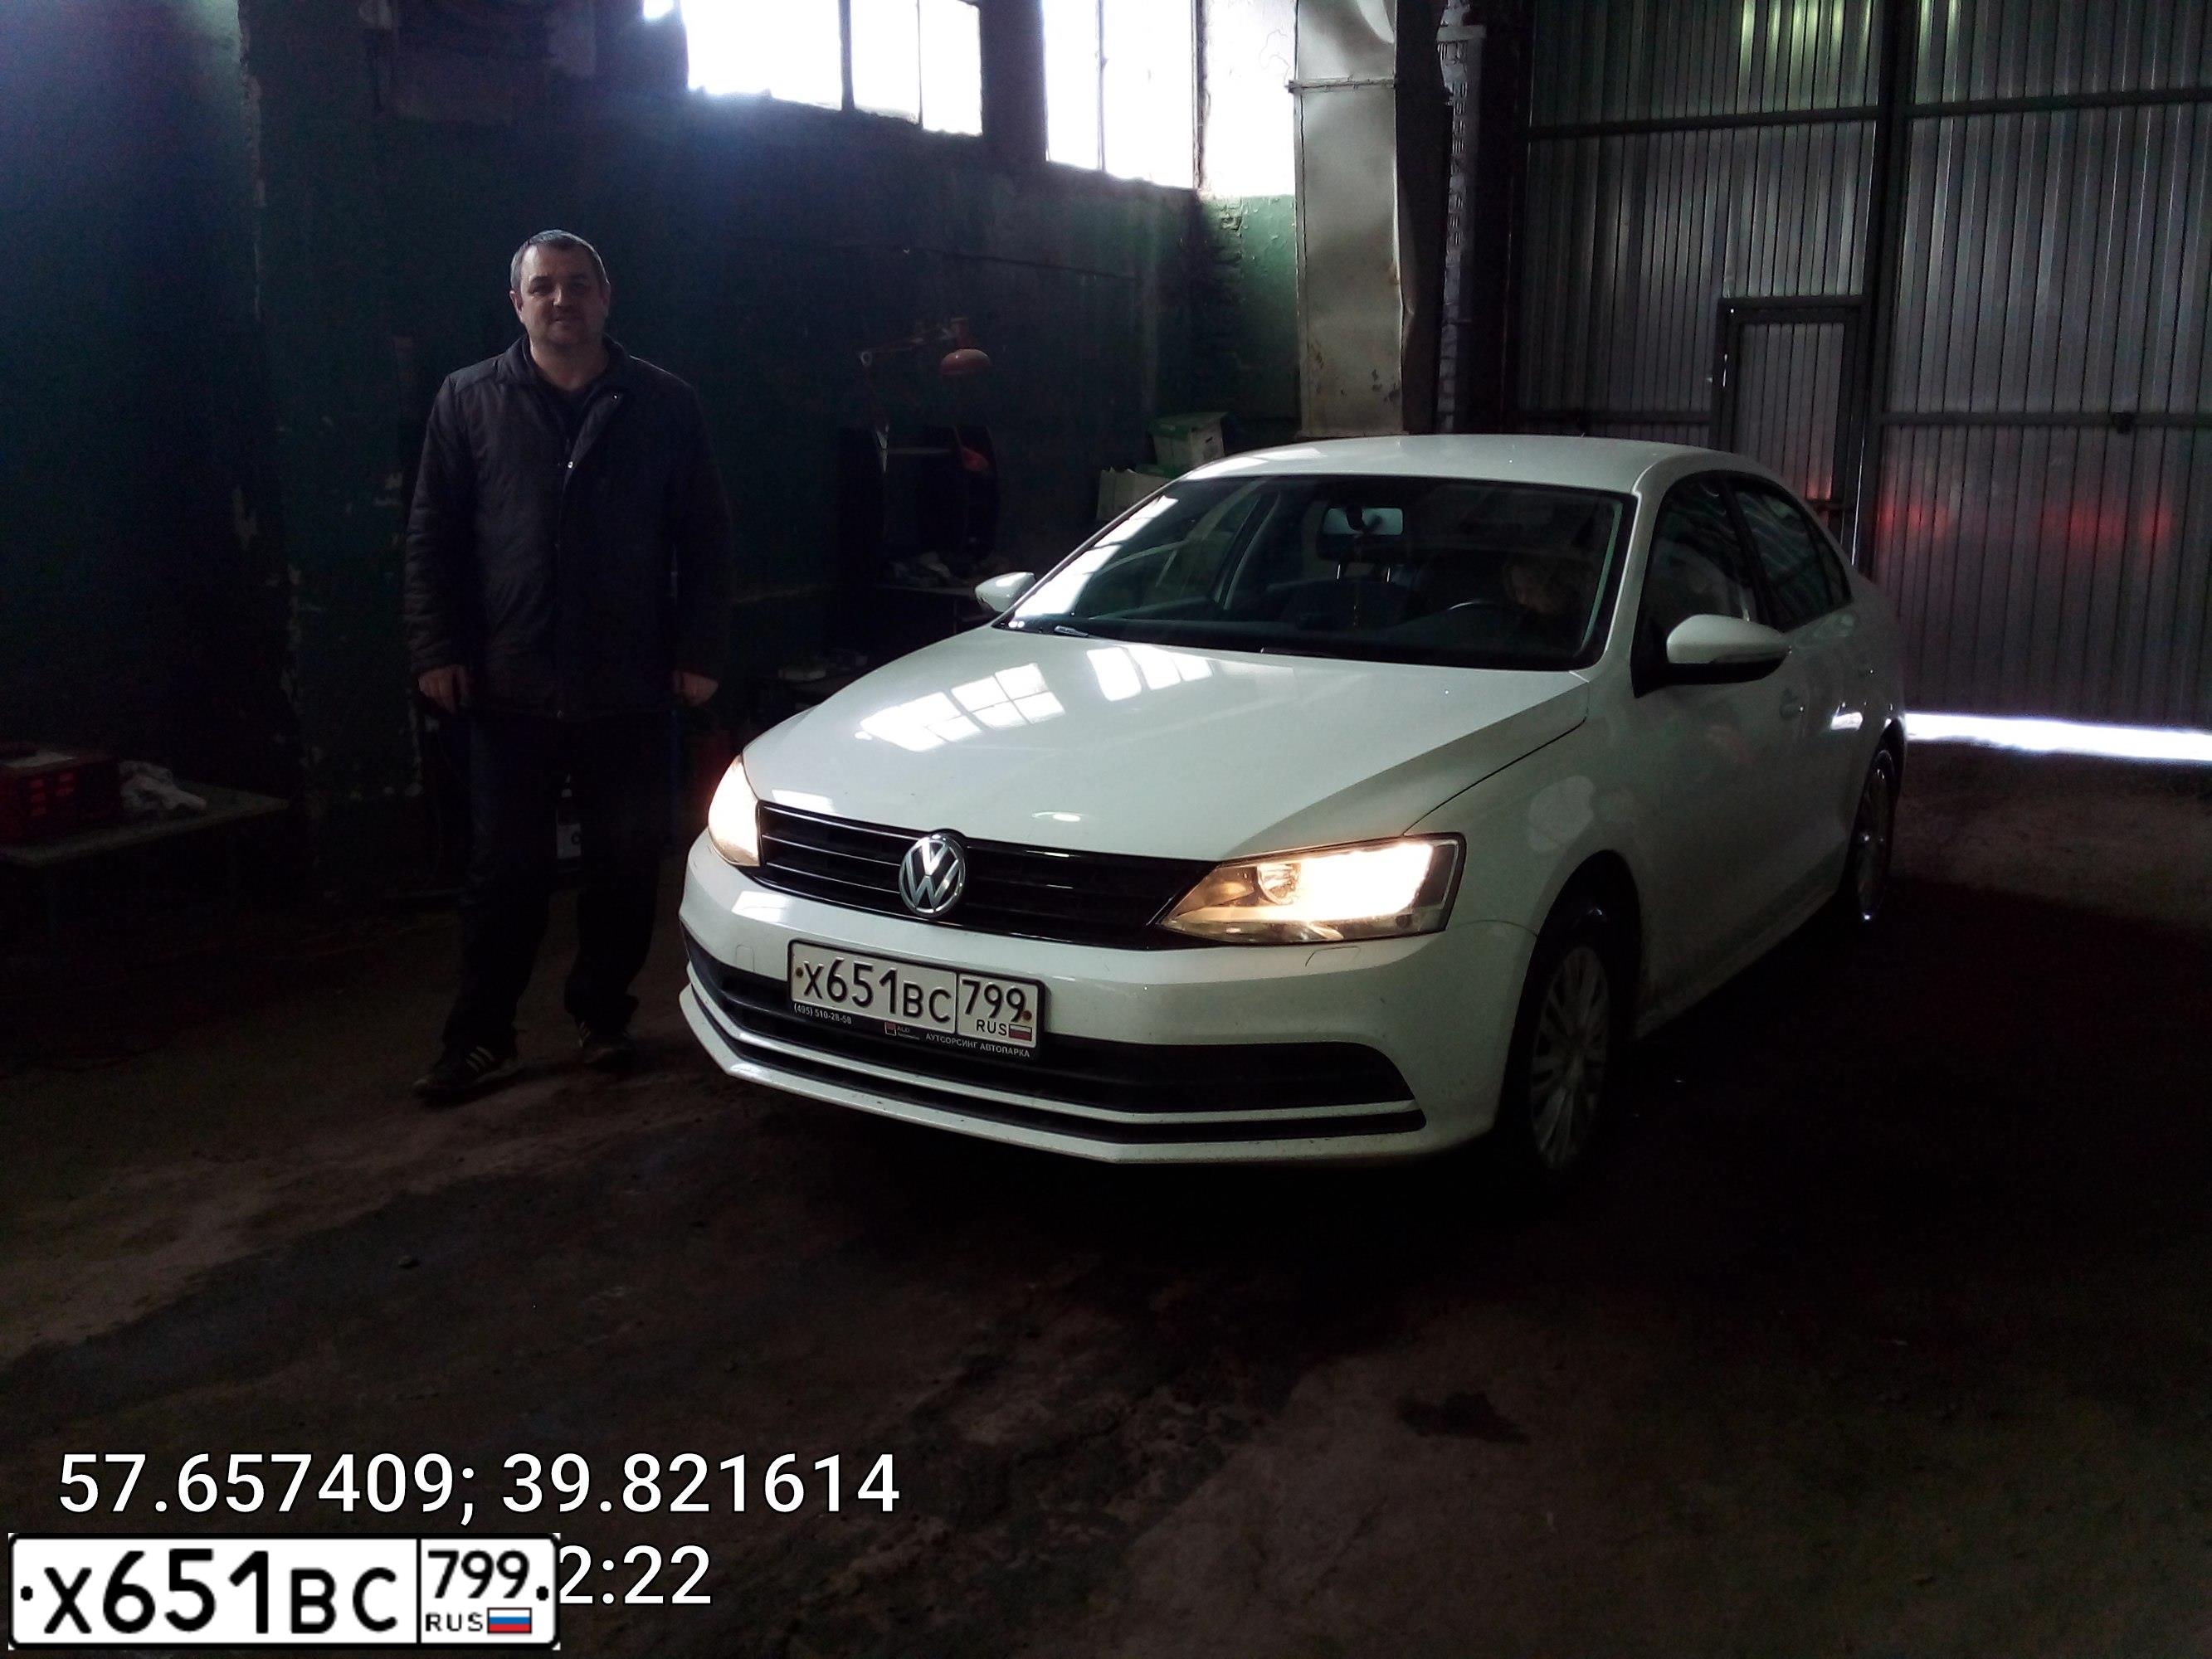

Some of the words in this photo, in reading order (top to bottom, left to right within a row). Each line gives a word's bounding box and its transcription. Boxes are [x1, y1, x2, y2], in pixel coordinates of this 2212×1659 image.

[794, 1003, 813, 1017] (495)
[960, 979, 1026, 1024] 799
[976, 1019, 1007, 1036] RUS
[925, 1033, 978, 1048] АУТСОРСИНГ
[980, 1043, 1030, 1058] АВТОПАРКА
